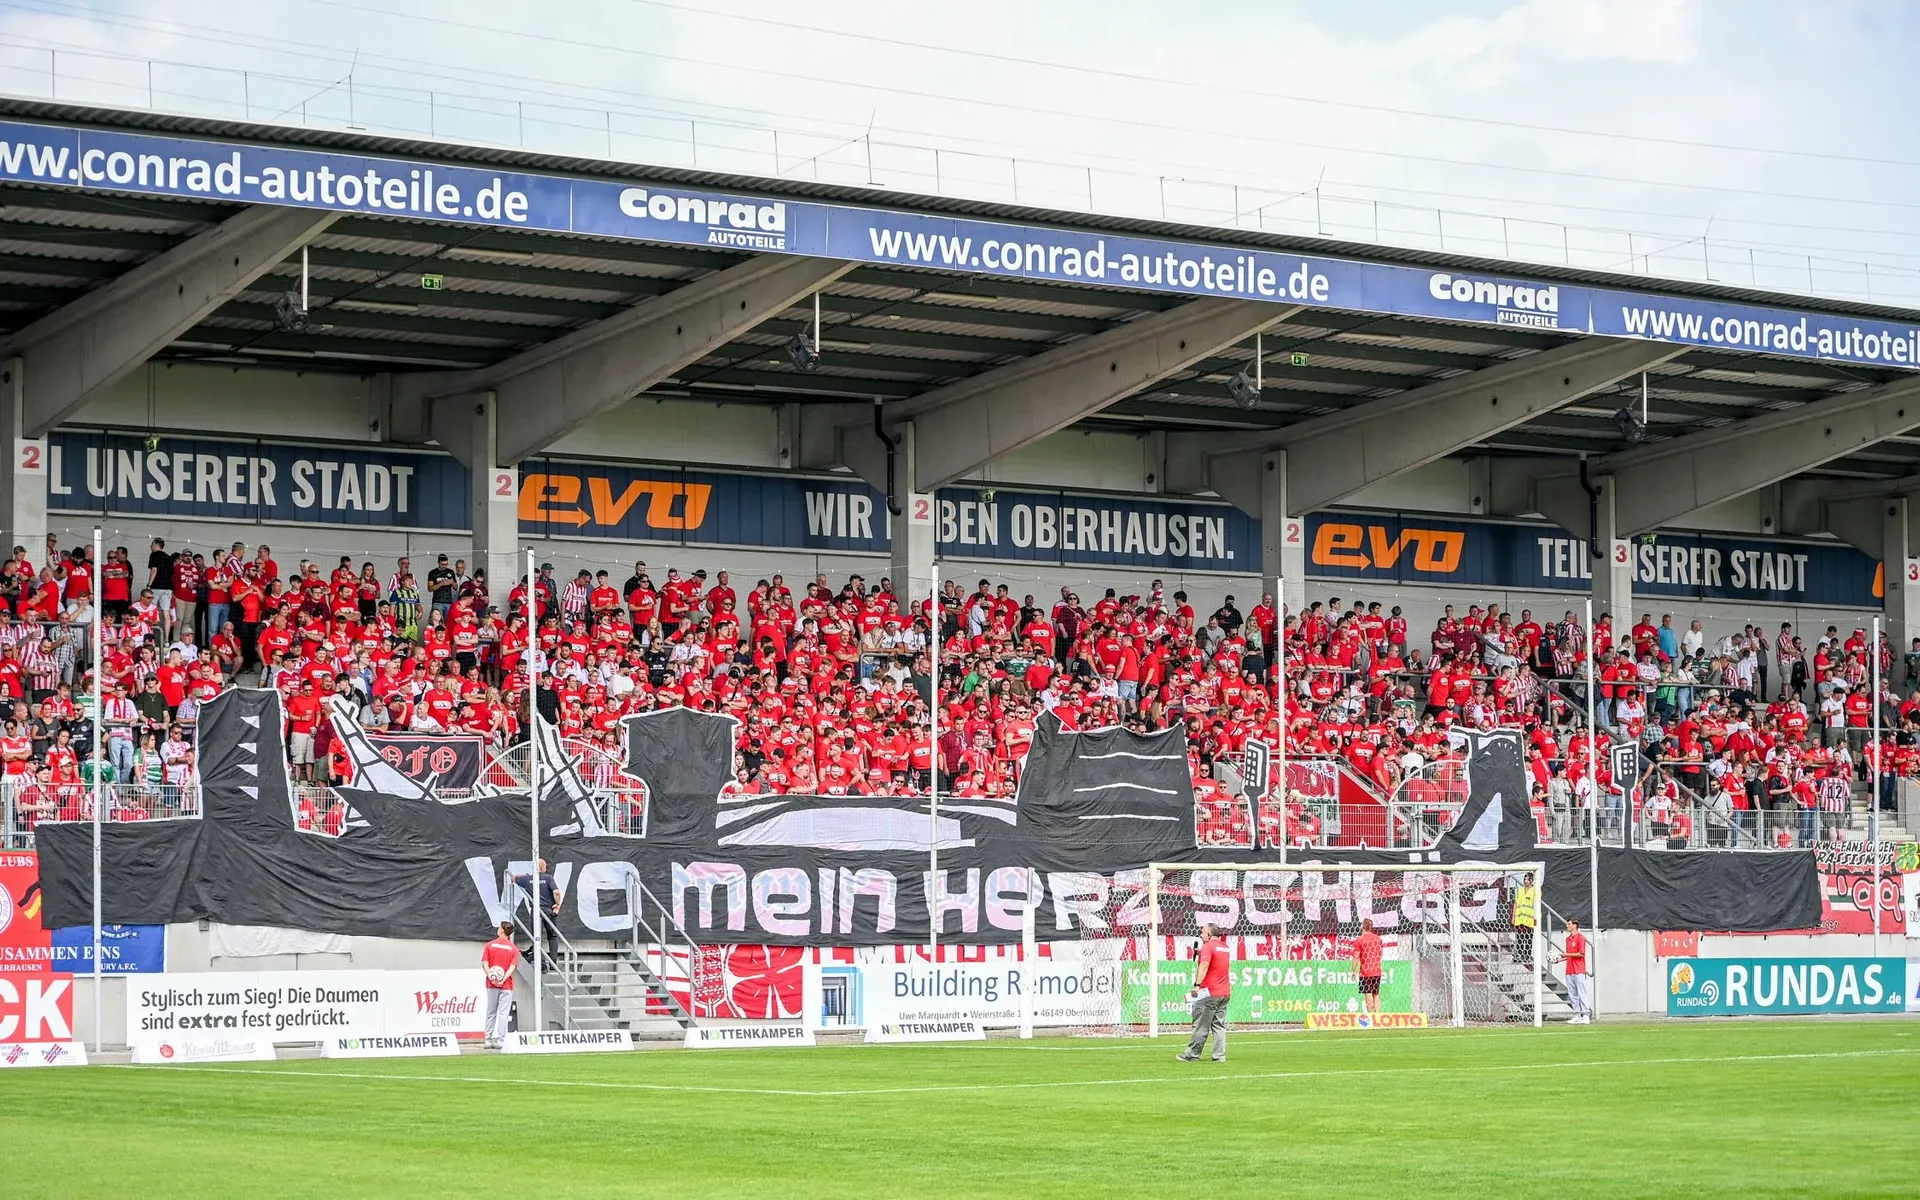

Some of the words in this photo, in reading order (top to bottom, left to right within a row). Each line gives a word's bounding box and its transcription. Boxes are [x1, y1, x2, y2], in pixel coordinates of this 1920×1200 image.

[620, 188, 785, 232] Conrad
[708, 231, 785, 250] AUTOTEILE
[869, 227, 1329, 301] www.conrad-autoteile.de
[1430, 274, 1558, 312] Conrad
[1499, 311, 1558, 328] AUTOTEILE
[22, 446, 40, 469] 2
[87, 447, 277, 506] UNSERER
[291, 460, 414, 513] STADT
[495, 475, 512, 496] 2
[518, 474, 712, 530] evo
[914, 499, 928, 520] 2
[805, 492, 873, 539] WIR
[1011, 504, 1235, 560] OBERHAUSEN.
[1287, 523, 1300, 543] 2
[1311, 523, 1465, 573] evo
[1615, 544, 1628, 563] 3
[1537, 537, 1592, 579] TEIL
[1731, 550, 1808, 592] STADT
[1908, 563, 1919, 581] 3
[1828, 785, 1843, 799] 12
[83, 945, 121, 960] ENS
[895, 969, 998, 1002] Building
[1007, 966, 1115, 996] Rmodel
[1242, 967, 1313, 986] STOAG
[1725, 964, 1883, 1007] RUNDAS
[141, 988, 203, 1011] Stylisch
[207, 992, 240, 1006] zum
[244, 988, 282, 1009] Sieg!
[288, 987, 312, 1004] Die
[315, 987, 379, 1003] Daumen
[414, 990, 479, 1014] Westfield
[1267, 1000, 1312, 1012] STOAG
[1317, 999, 1340, 1012] App
[1677, 997, 1708, 1007] RUNDAS
[141, 1011, 174, 1030] sind
[178, 1012, 238, 1029] extra
[242, 1009, 272, 1027] fest
[275, 1008, 350, 1031] gedrückt.
[431, 1016, 461, 1028] CENTRO
[899, 1011, 916, 1020] Uwe
[918, 1011, 960, 1023] Marquardt
[970, 1009, 1015, 1019] Weierstraße
[1040, 1008, 1063, 1018] 46149
[1065, 1008, 1110, 1018] Oberhausen
[1311, 1014, 1357, 1028] WEST
[1371, 1013, 1423, 1028] LOTTO
